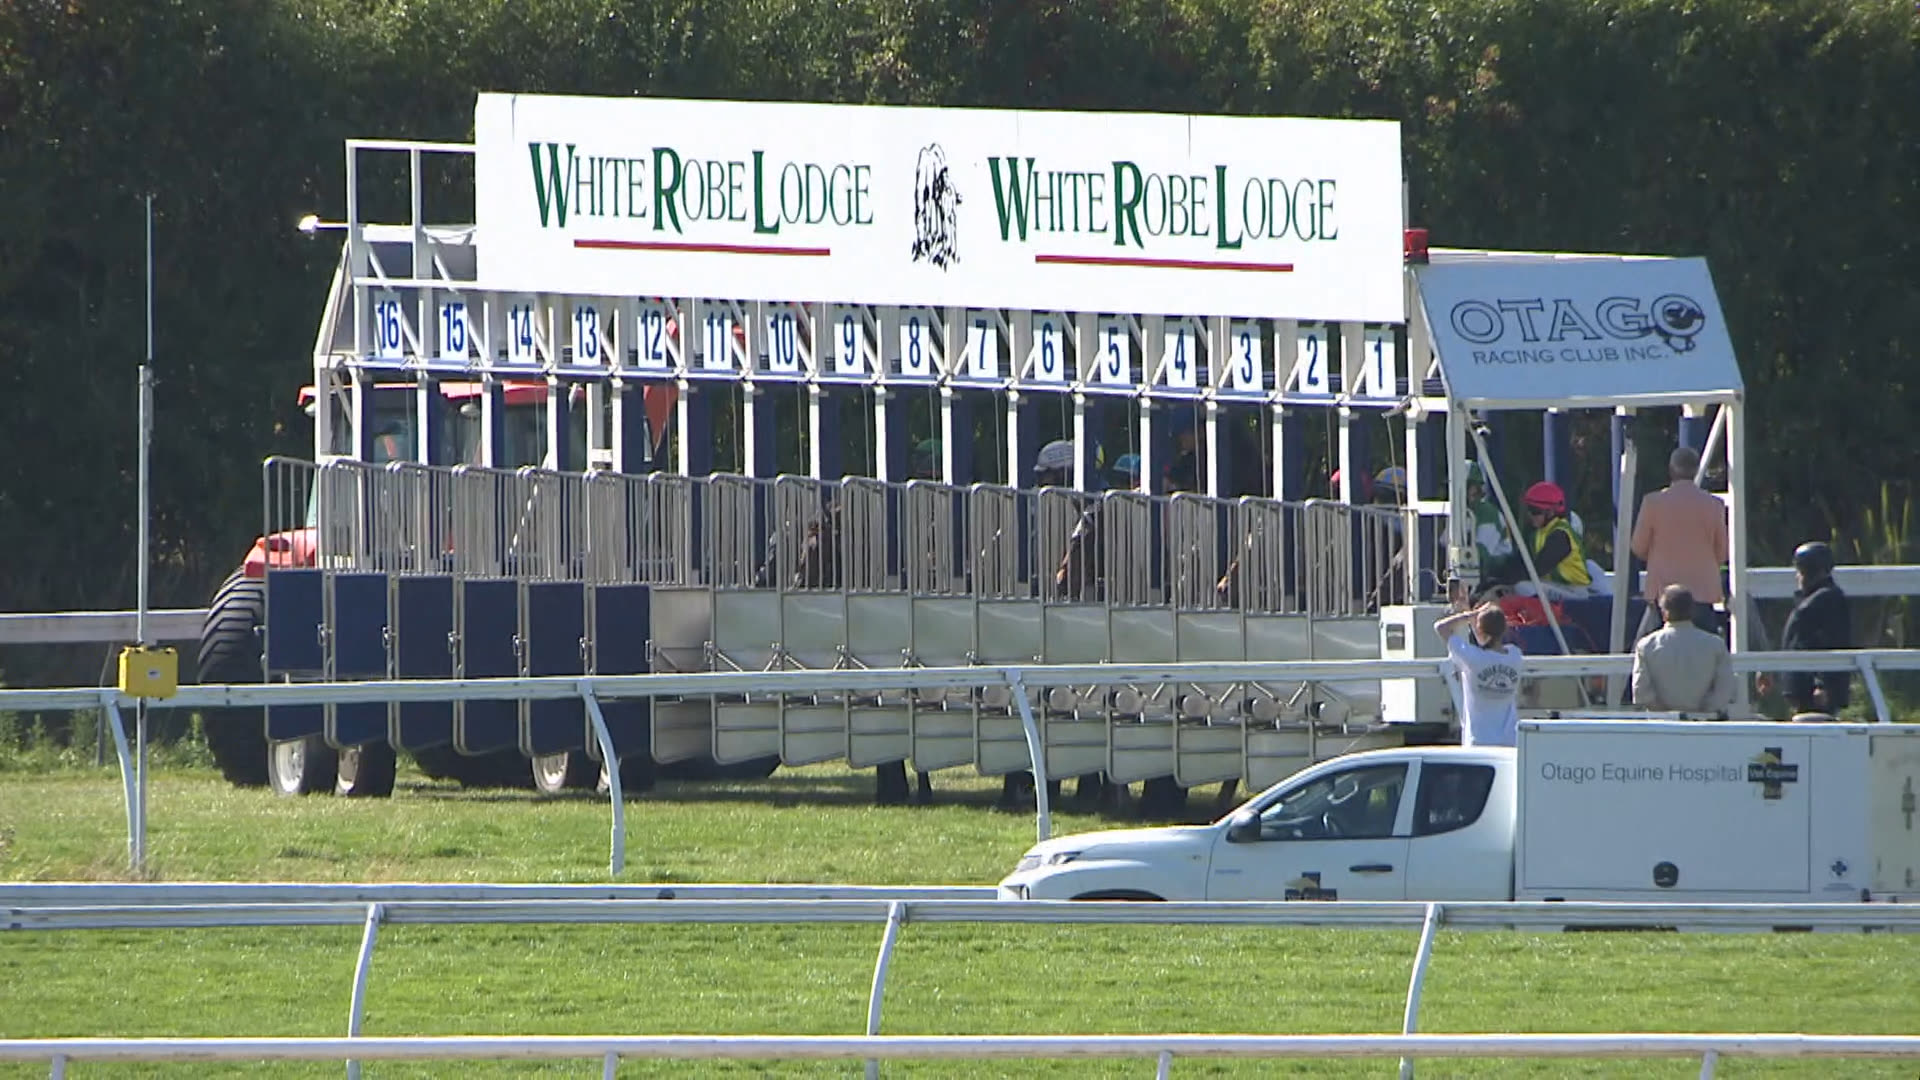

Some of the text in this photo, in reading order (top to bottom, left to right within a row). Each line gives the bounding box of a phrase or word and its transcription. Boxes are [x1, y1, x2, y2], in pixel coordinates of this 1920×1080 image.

[377, 301, 401, 349] 16
[442, 303, 465, 352] 15
[510, 305, 533, 356] 14
[575, 305, 598, 358] 13
[640, 311, 663, 361] 12
[706, 311, 727, 362] 11
[770, 313, 795, 365] 10
[843, 315, 857, 366] 9
[909, 317, 922, 368] 8
[1450, 293, 1706, 344] OTAGO
[975, 320, 990, 370] 7
[1042, 322, 1056, 374] 6
[1108, 328, 1121, 376] 5
[1174, 329, 1188, 380] 4
[1240, 333, 1254, 384] 3
[1306, 335, 1320, 386] 2
[1373, 337, 1384, 390] 1
[1473, 346, 1669, 365] RACING CLUB INC.
[1541, 763, 1596, 785] Otago
[1602, 763, 1664, 785] Equine
[1669, 764, 1742, 784] Hospital
